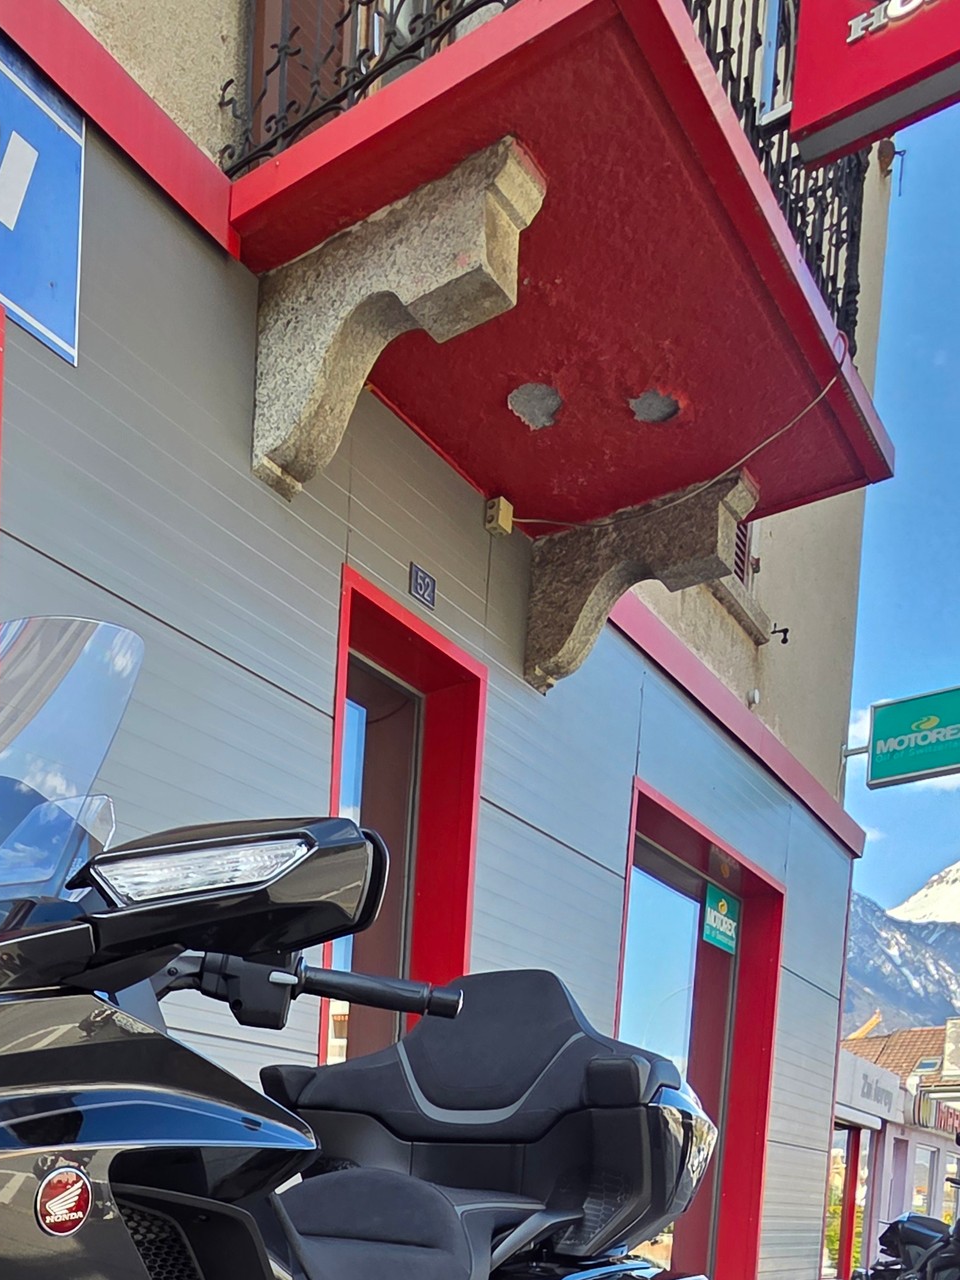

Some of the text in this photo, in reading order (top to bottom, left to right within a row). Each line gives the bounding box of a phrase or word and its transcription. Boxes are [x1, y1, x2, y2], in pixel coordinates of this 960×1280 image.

[845, 0, 940, 43] HO
[417, 570, 432, 601] 52
[705, 906, 737, 938] MOTOREX
[45, 1211, 84, 1223] HONDA
